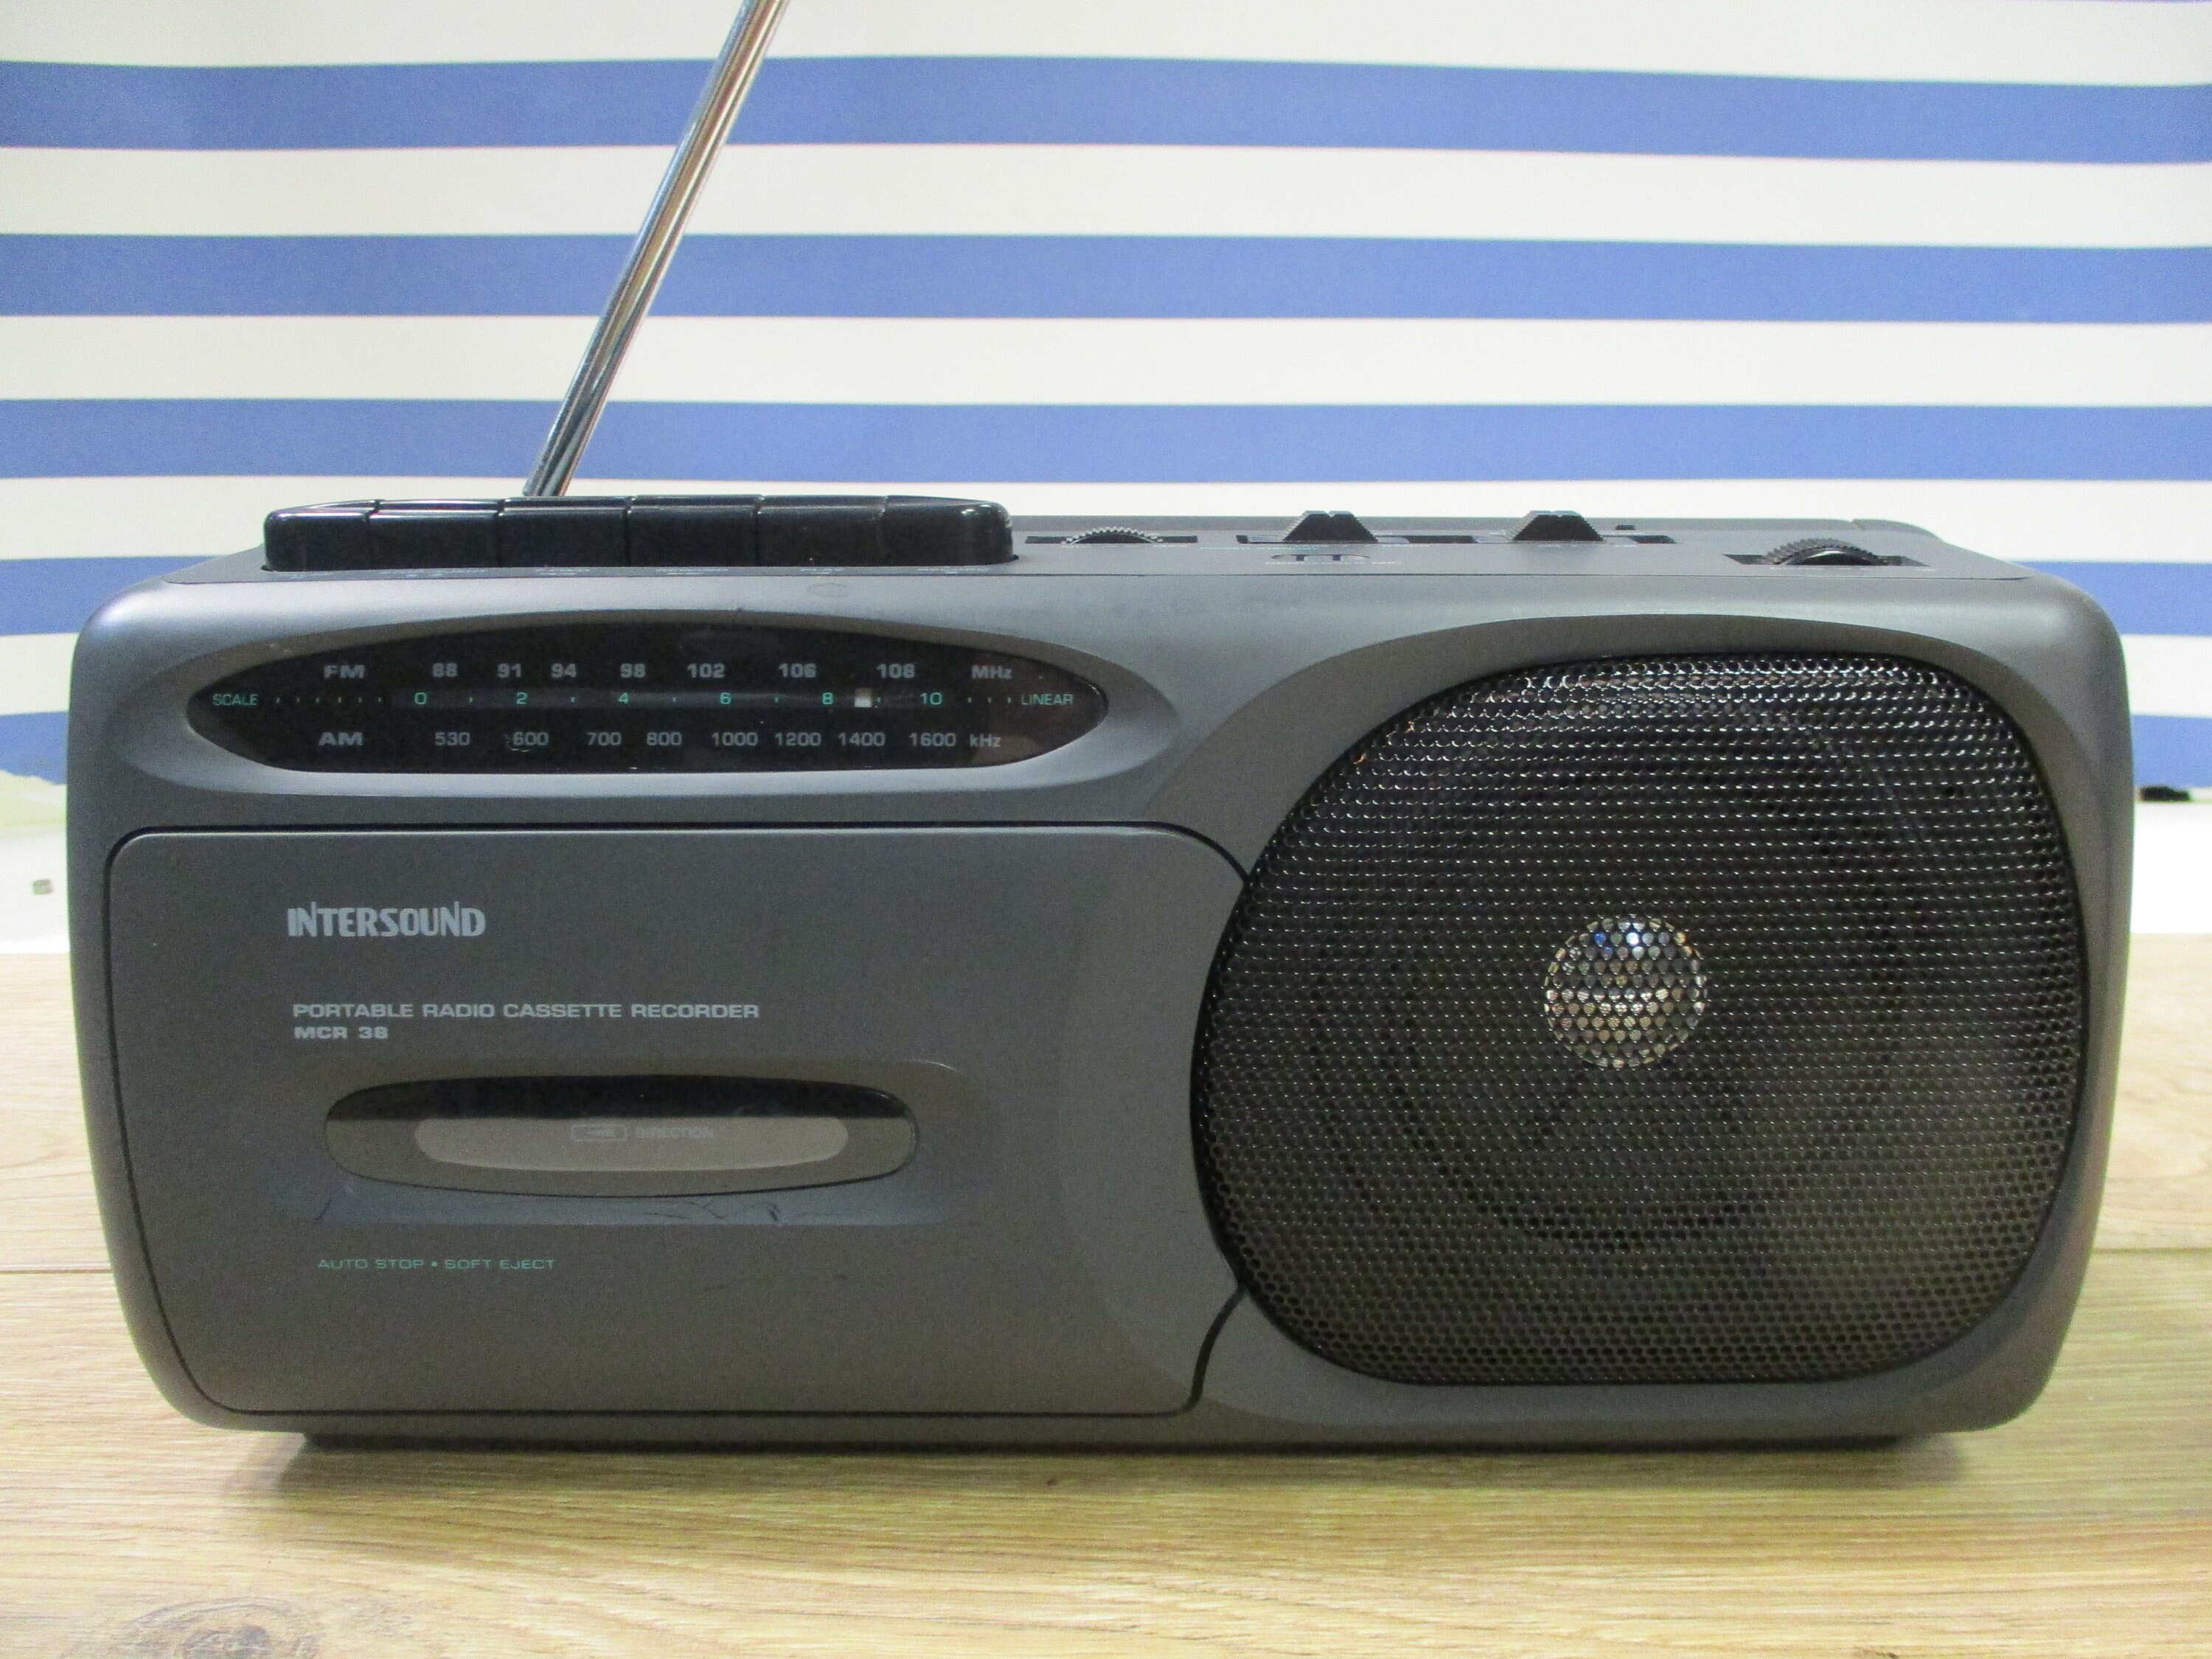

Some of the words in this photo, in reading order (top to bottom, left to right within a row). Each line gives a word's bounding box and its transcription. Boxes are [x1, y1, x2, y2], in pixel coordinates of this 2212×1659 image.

[324, 664, 365, 679] FM
[433, 664, 458, 679] 88
[498, 664, 522, 678] 91
[551, 664, 577, 679] 94
[620, 664, 646, 679] 98
[687, 664, 726, 679] 102
[779, 664, 817, 679] 106
[876, 664, 916, 679] 108
[972, 664, 1012, 681] MHz
[212, 693, 259, 707] SCALE
[516, 692, 529, 705] 2
[617, 692, 630, 705] 4
[720, 692, 732, 706] 6
[821, 692, 834, 706] 8
[920, 692, 943, 706] 10
[1020, 694, 1074, 707] LINEAR
[318, 732, 364, 747] AM
[434, 732, 471, 747] 530
[512, 732, 549, 747] 600
[586, 732, 622, 747] 700
[647, 732, 682, 747] 800
[711, 732, 759, 748] 1000
[774, 732, 822, 748] 1200
[838, 732, 886, 748] 1400
[908, 732, 956, 748] 1600
[970, 734, 1001, 748] kHz
[286, 900, 486, 938] INTERSOUND
[293, 1004, 414, 1018] PORTABLE
[422, 1004, 495, 1018] RADIO
[503, 1004, 622, 1018] CASSETTE
[630, 1004, 761, 1018] RECORDER
[294, 1026, 348, 1040] MCR
[317, 1258, 369, 1270] AUTO
[375, 1258, 425, 1270] STOP
[444, 1258, 493, 1270] SOFT
[499, 1258, 556, 1270] EJECT
